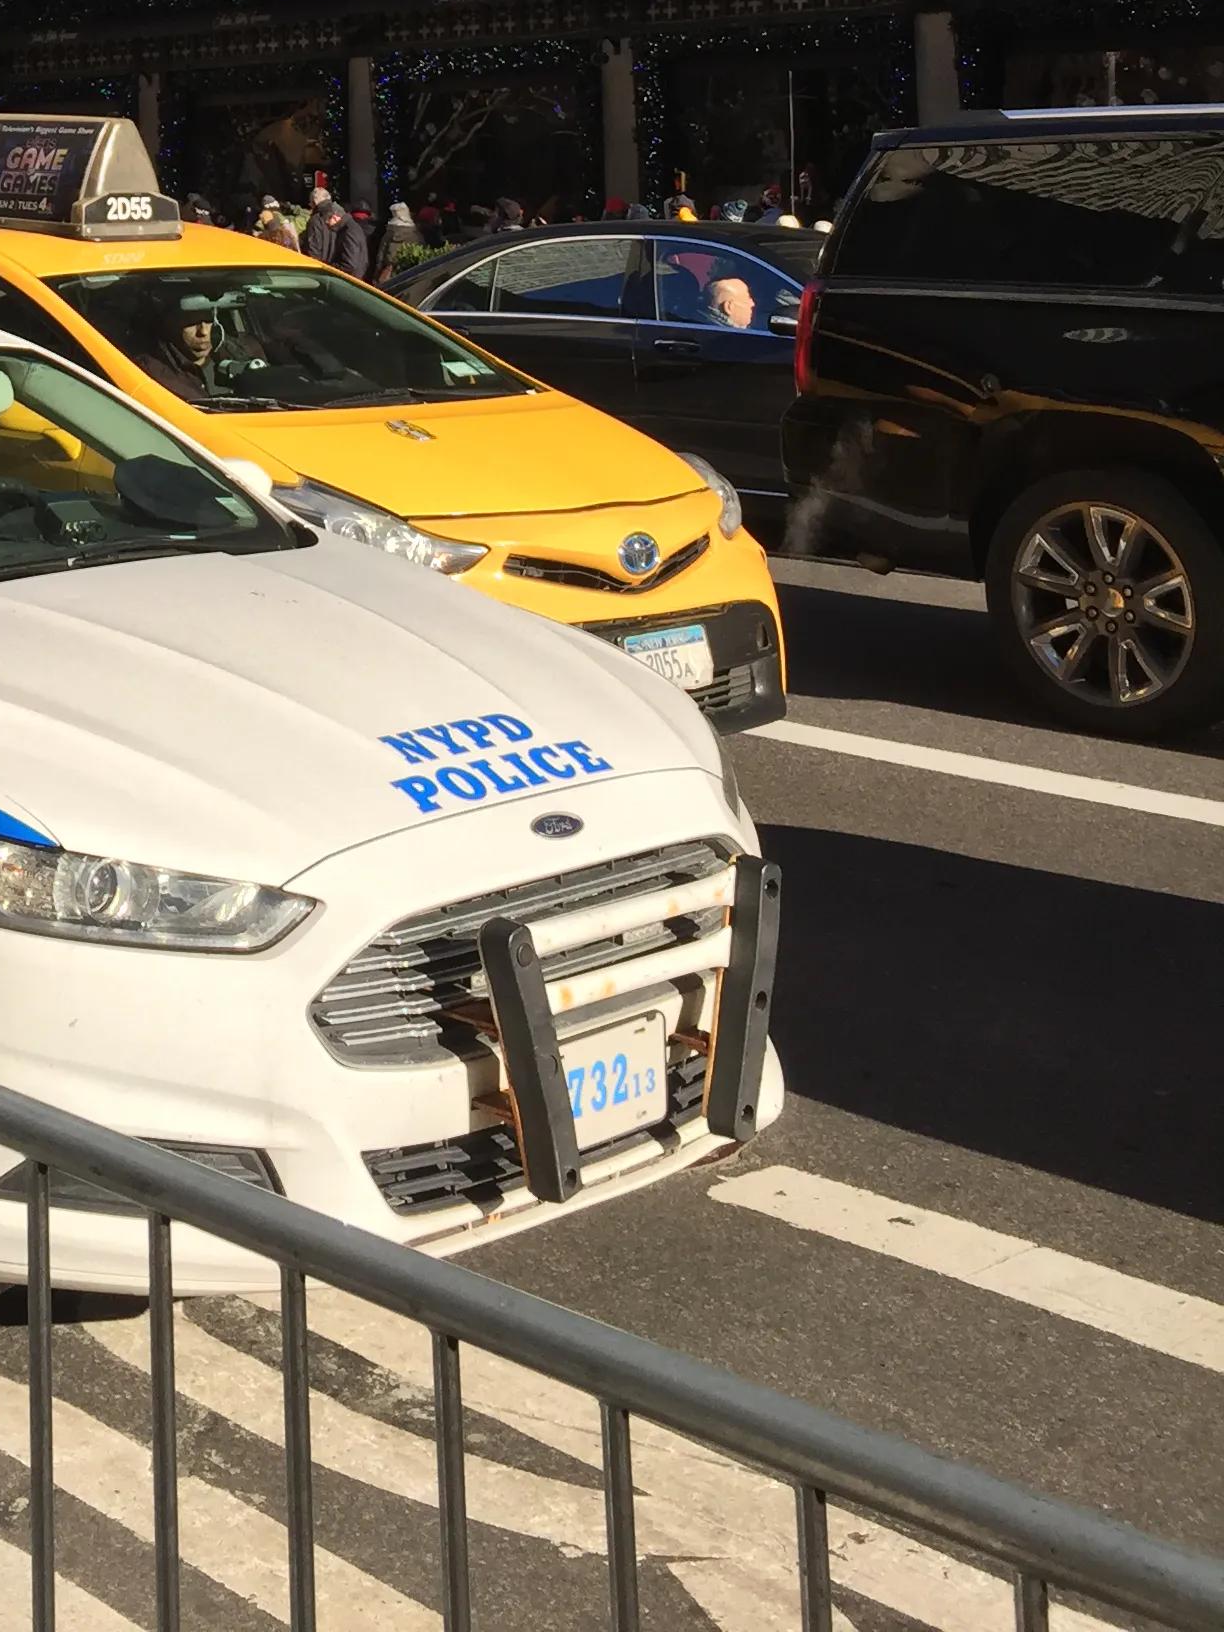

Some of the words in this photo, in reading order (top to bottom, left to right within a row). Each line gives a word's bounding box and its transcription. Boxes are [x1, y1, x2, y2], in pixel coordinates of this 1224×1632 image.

[6, 147, 69, 171] GAME
[0, 172, 58, 194] GAMES
[8, 200, 15, 209] 2
[18, 200, 38, 210] TUES
[106, 196, 153, 220] 2D55
[376, 713, 533, 765] NYPD
[389, 740, 614, 814] POLICE
